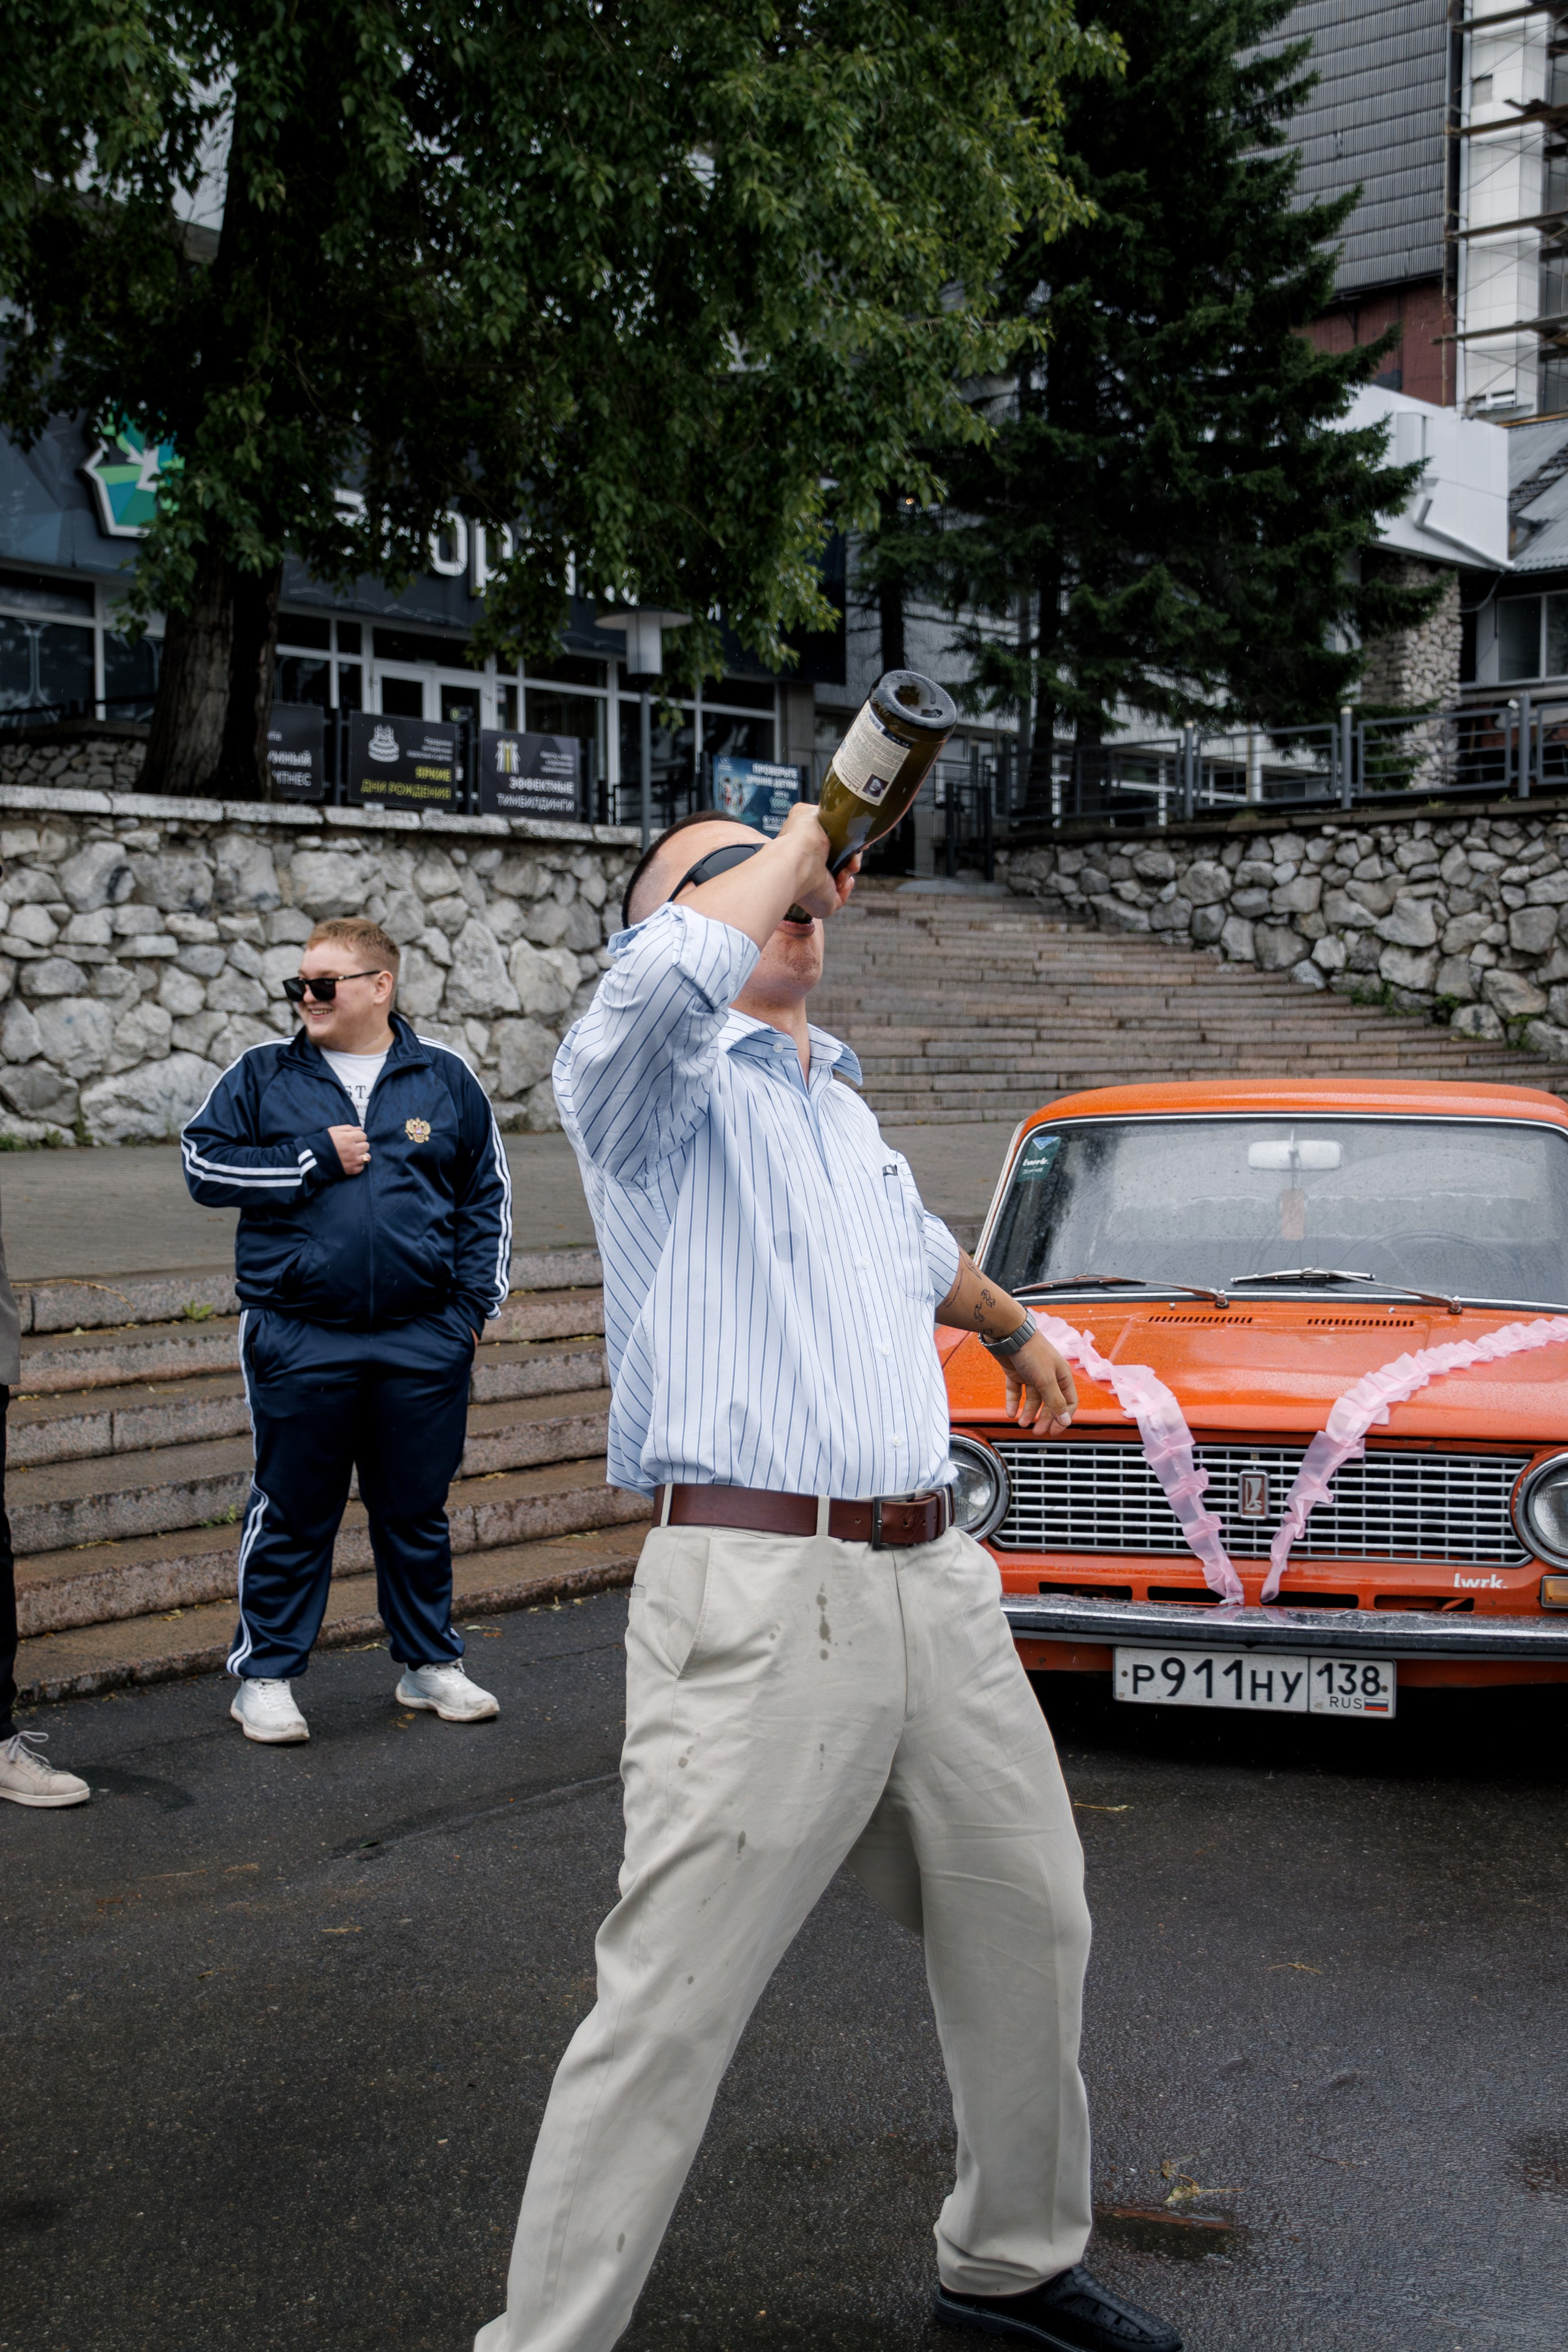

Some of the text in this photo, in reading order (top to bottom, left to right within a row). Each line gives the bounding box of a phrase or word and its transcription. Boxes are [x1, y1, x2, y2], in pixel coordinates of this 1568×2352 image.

[416, 766, 451, 782] ЯРКИЕ
[361, 779, 451, 800] ДНИ РОЖДЕНИЯ
[510, 776, 575, 794] ЭФФЕКТНЫЕ
[497, 793, 575, 812] ТИМБИЛДИНГИ
[1316, 1662, 1381, 1696] 138
[1330, 1696, 1362, 1709] RUS
